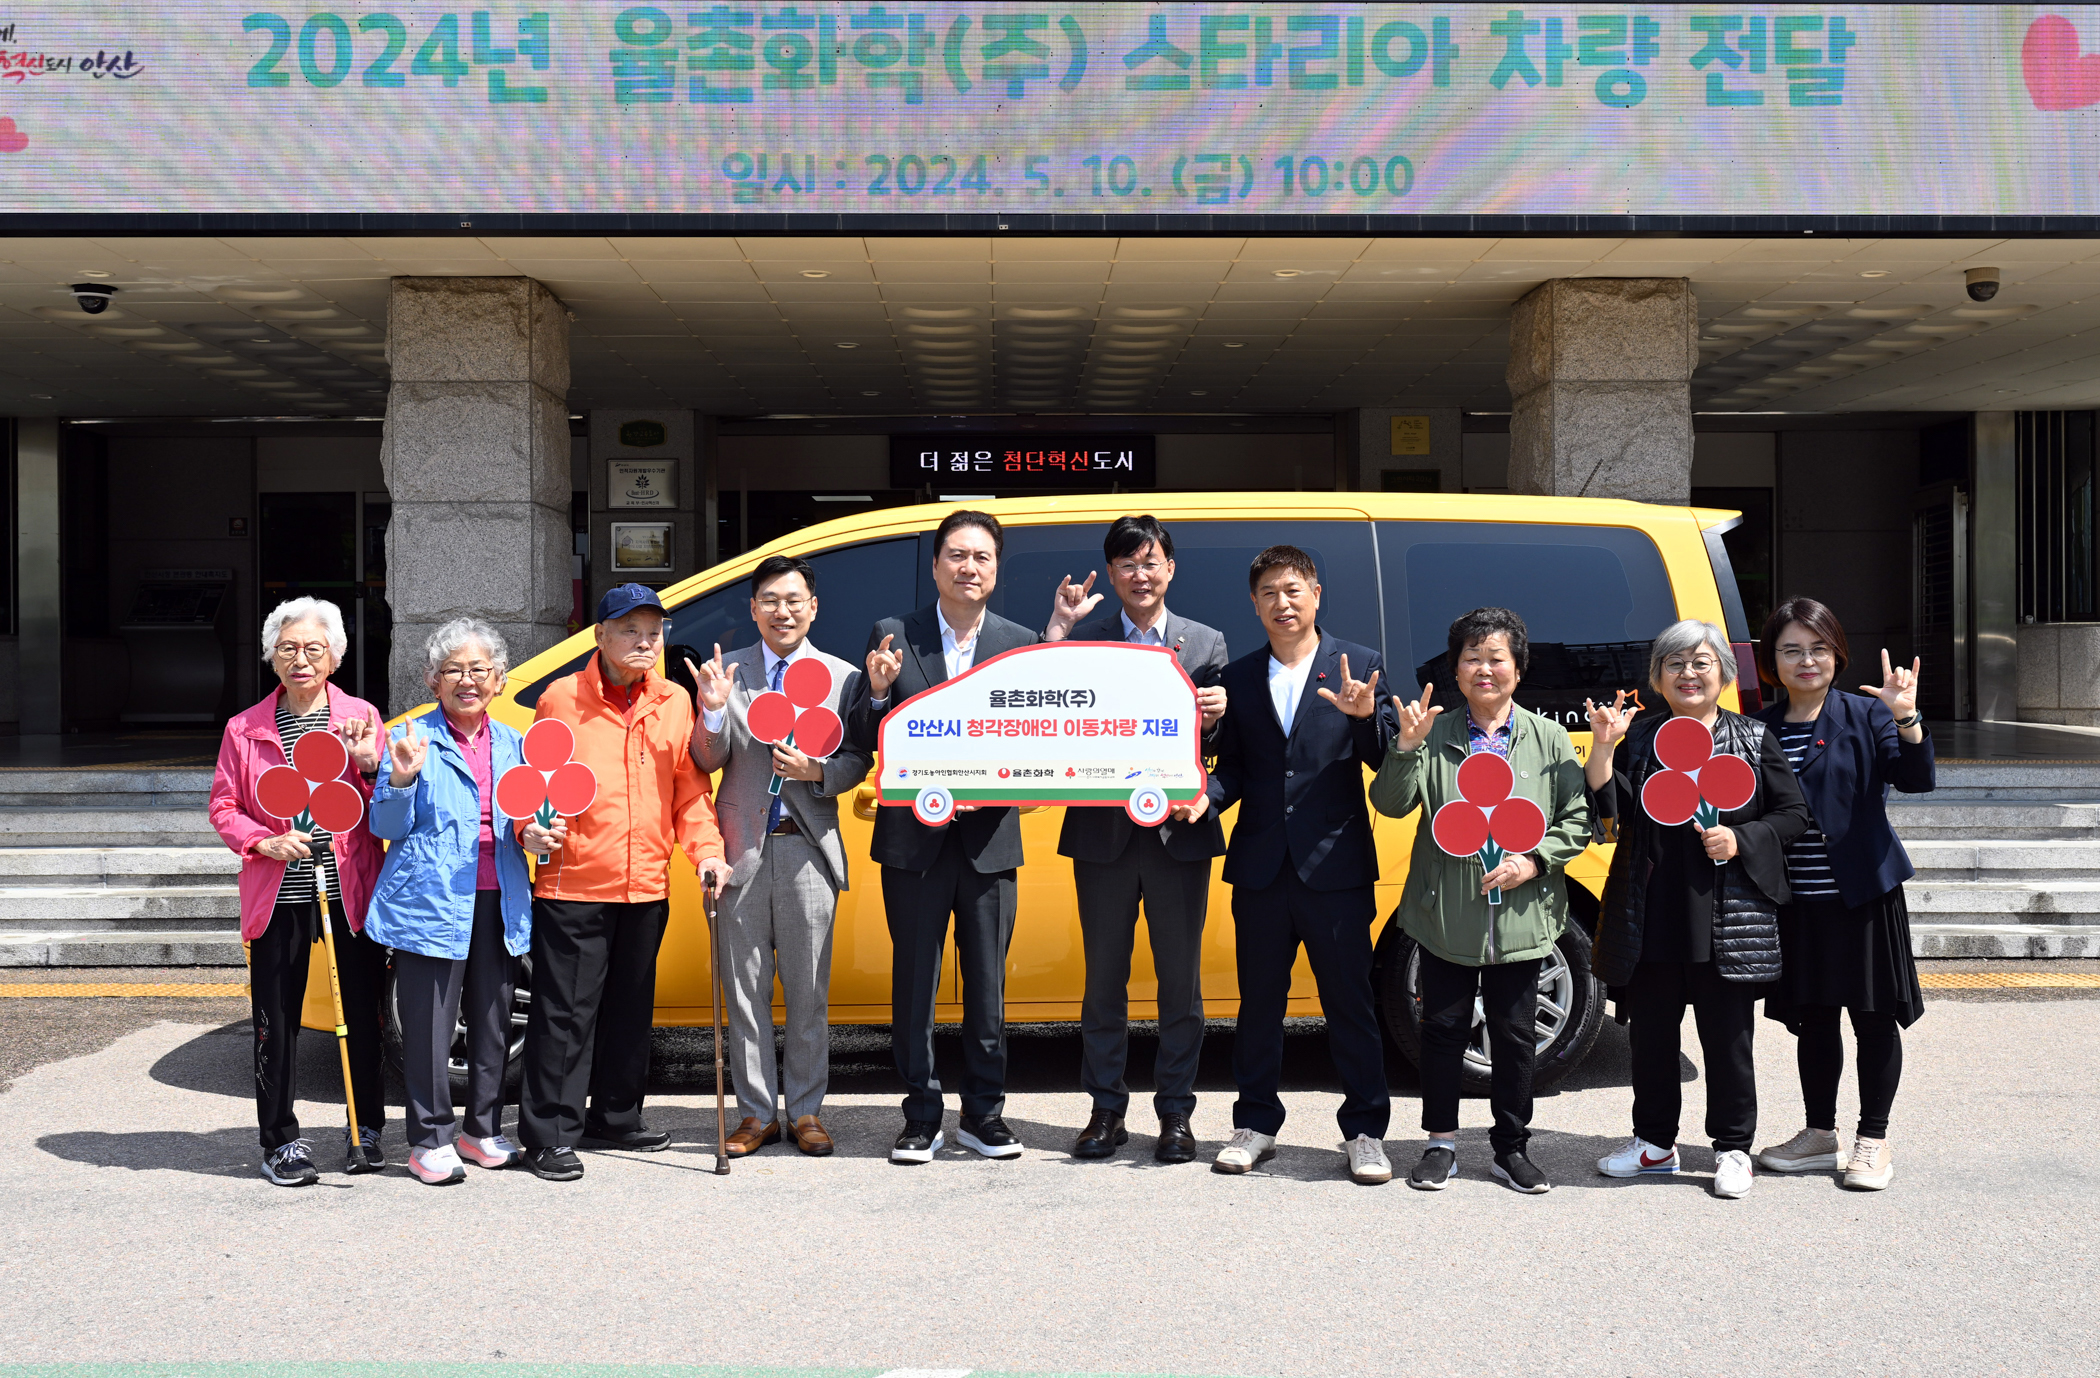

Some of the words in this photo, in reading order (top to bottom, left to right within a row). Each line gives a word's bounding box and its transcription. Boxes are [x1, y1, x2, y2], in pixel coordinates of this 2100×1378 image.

[79, 50, 145, 79] 안산
[242, 11, 549, 103] 2024년
[609, 5, 1088, 105] 율촌화학(주)
[1122, 14, 1459, 91] 스타리아
[1489, 10, 1660, 107] 차량
[1689, 14, 1856, 107] 전달
[721, 152, 816, 203] 일시
[1173, 153, 1255, 205] (금)
[1274, 154, 1415, 197] 10:00
[919, 450, 939, 472] 더
[949, 450, 994, 472] 젊은
[1002, 450, 1133, 472] 첨단혁신도시
[989, 689, 1096, 709] 율촌화학(주)
[907, 718, 961, 738] 안산시
[966, 718, 1058, 738] 청각장애인
[1063, 718, 1138, 737] 이동차량
[1142, 718, 1179, 737] 지원
[1012, 768, 1054, 777] 율촌화학
[1077, 767, 1115, 776] 사랑의열매
